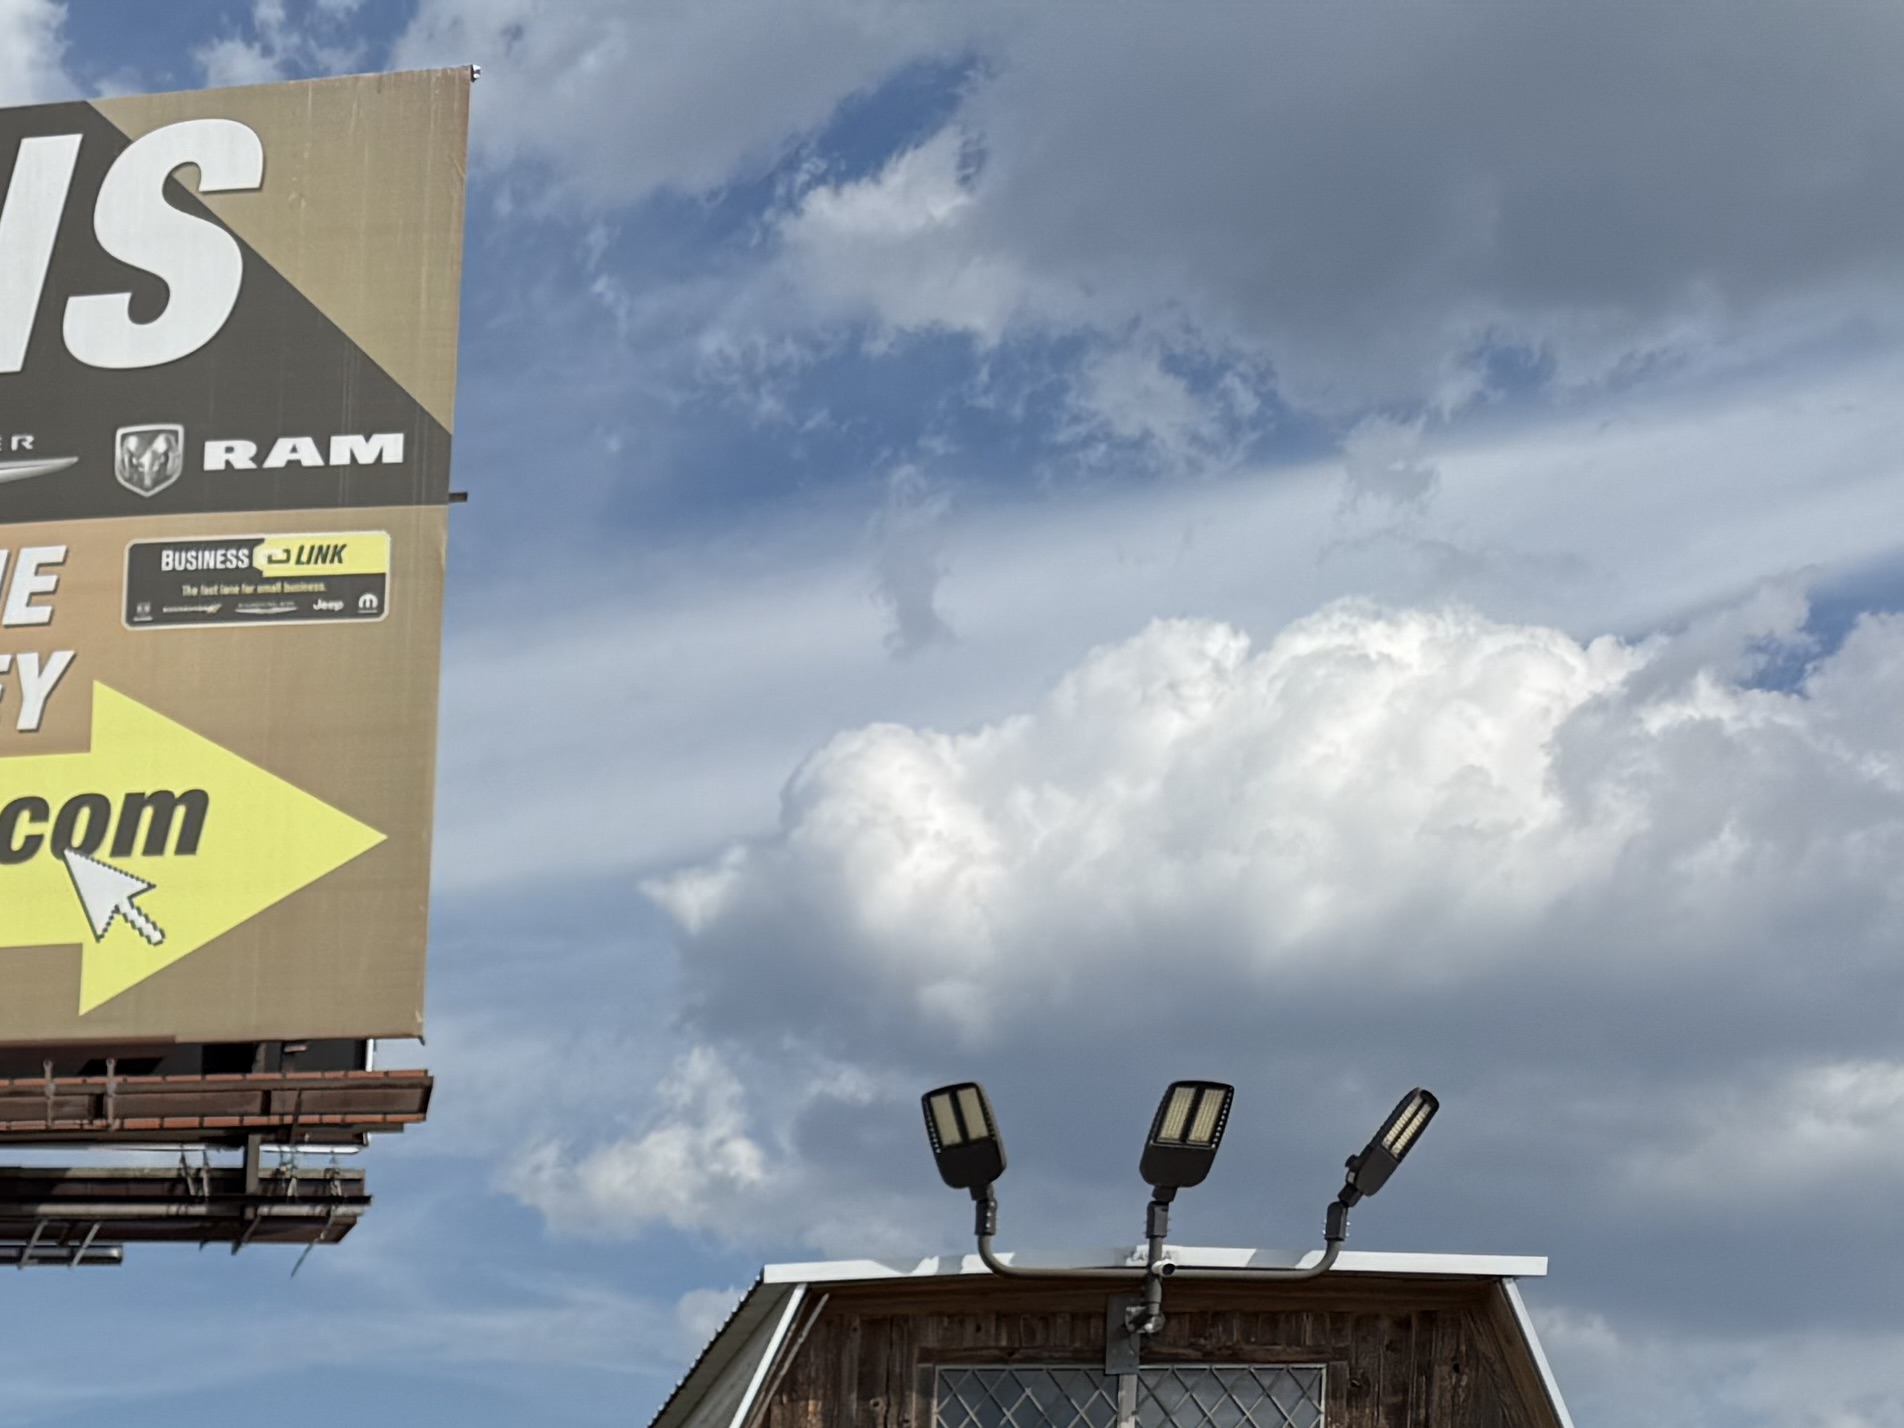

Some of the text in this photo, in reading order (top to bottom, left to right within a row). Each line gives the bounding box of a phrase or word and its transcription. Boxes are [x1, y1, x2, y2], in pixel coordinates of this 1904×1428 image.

[202, 431, 406, 472] RAM
[160, 543, 347, 572] BUSINESS LINK
[181, 584, 198, 597] The
[312, 598, 344, 612] Jeep
